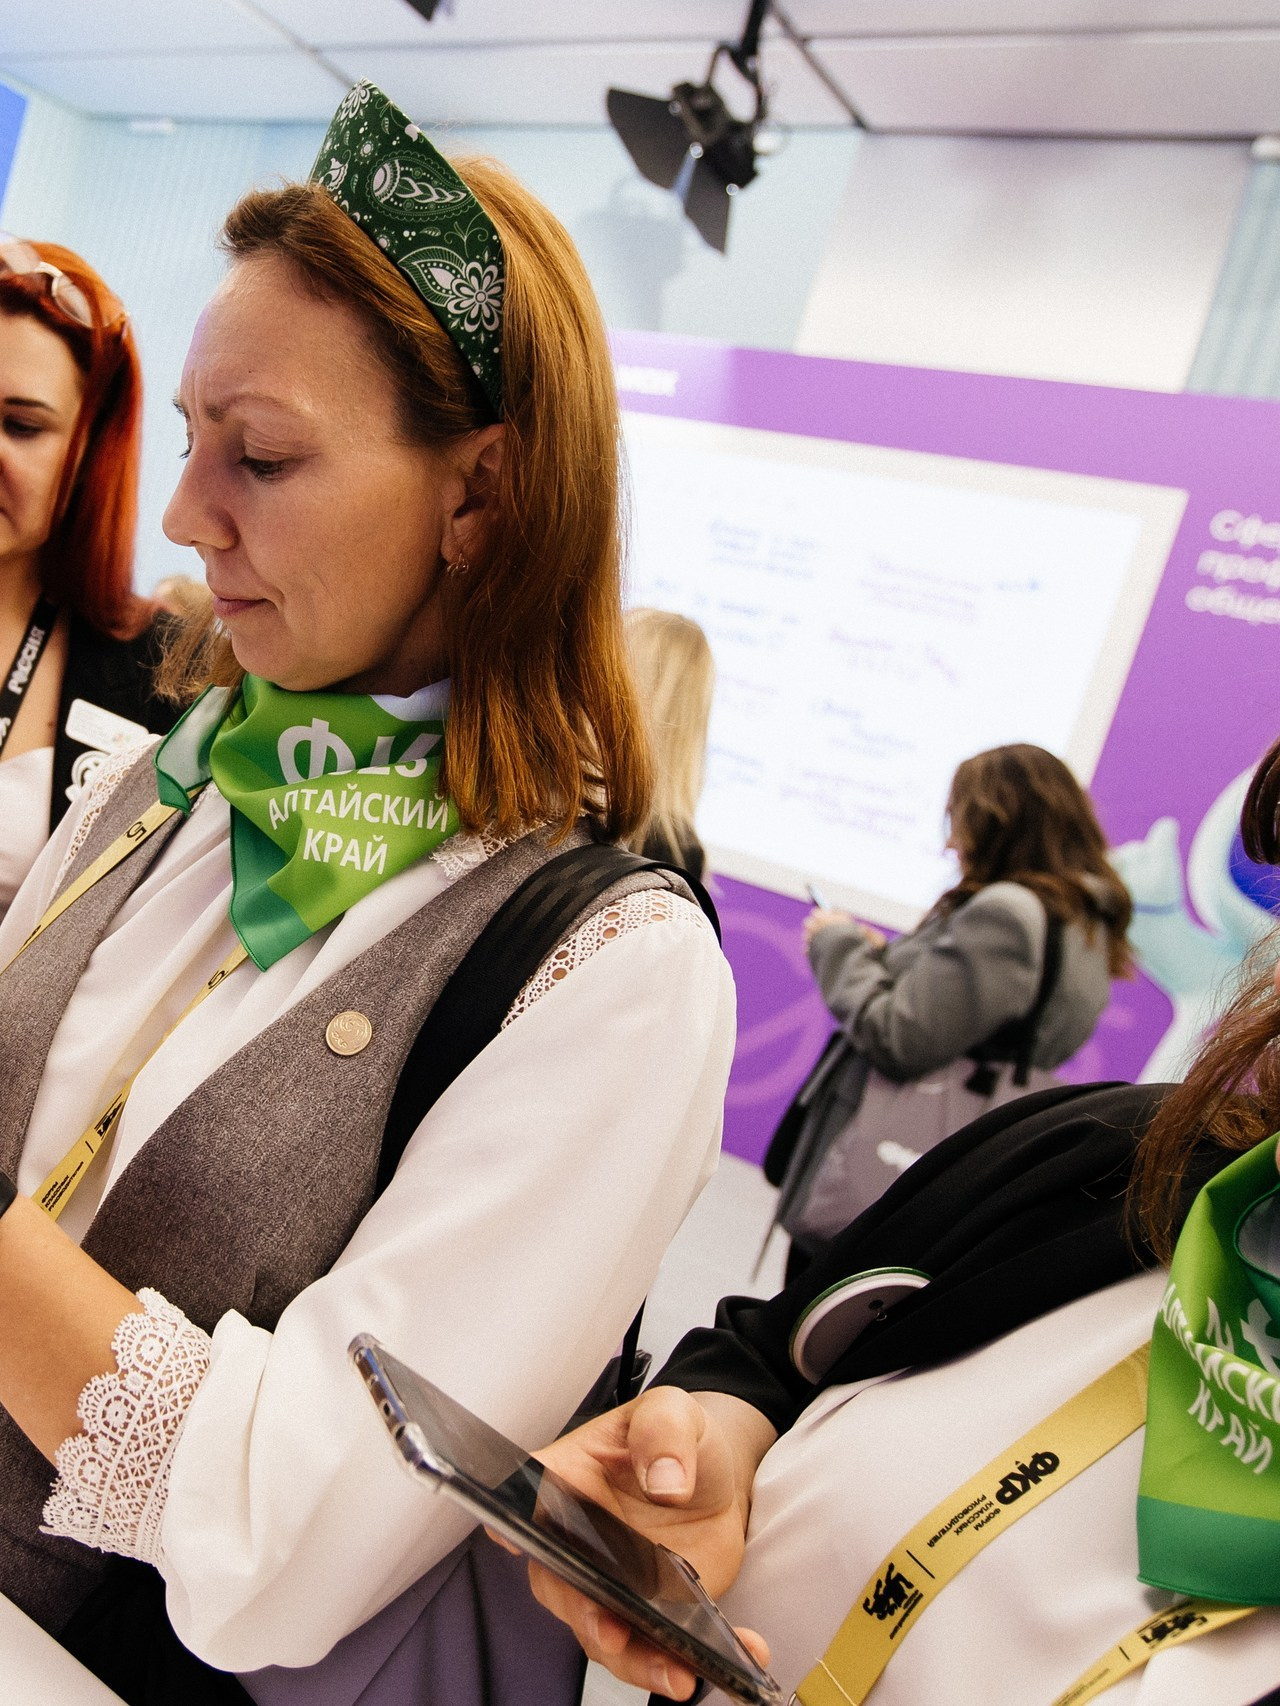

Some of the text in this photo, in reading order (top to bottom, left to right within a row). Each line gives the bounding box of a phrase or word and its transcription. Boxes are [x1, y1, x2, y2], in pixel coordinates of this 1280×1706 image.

[269, 783, 448, 832] АЛТАЙСКИЙ
[303, 828, 388, 875] КРАЙ
[1187, 1378, 1273, 1475] КРАЙ
[995, 1451, 1060, 1505] ФКР
[926, 1494, 987, 1548] РУКОВОДИТЕЛЕЙ
[953, 1501, 994, 1536] КЛАССНЫХ
[973, 1507, 1001, 1531] ФОРУМ
